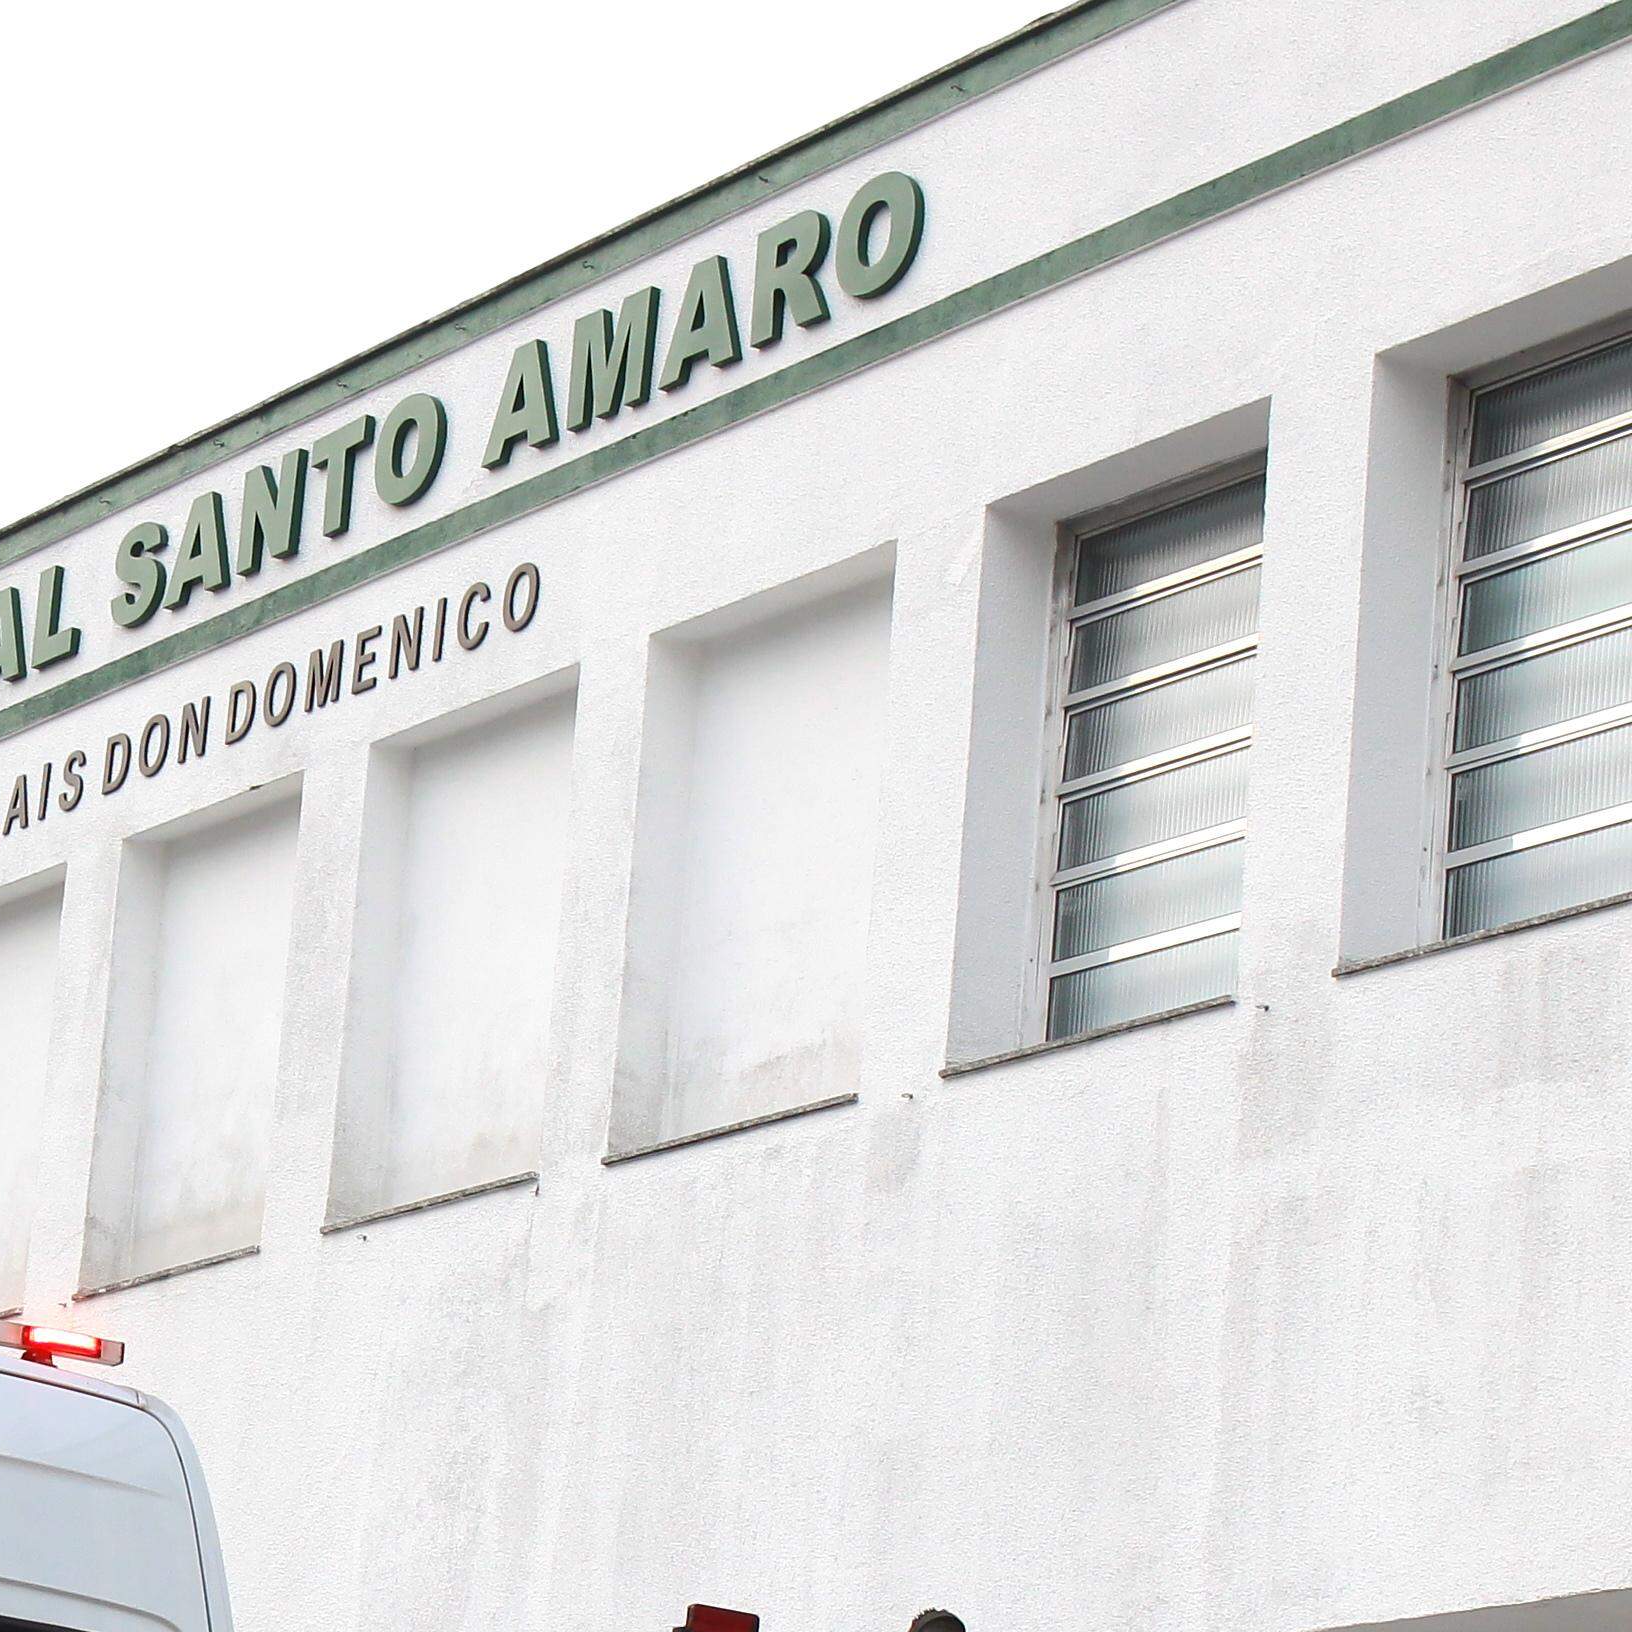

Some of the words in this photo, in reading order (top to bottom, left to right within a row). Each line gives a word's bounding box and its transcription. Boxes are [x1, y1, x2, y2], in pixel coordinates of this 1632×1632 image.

[112, 393, 448, 627] SANTO
[482, 171, 925, 470] AMARO
[101, 696, 210, 796] DON
[224, 561, 541, 746] DOMENICO
